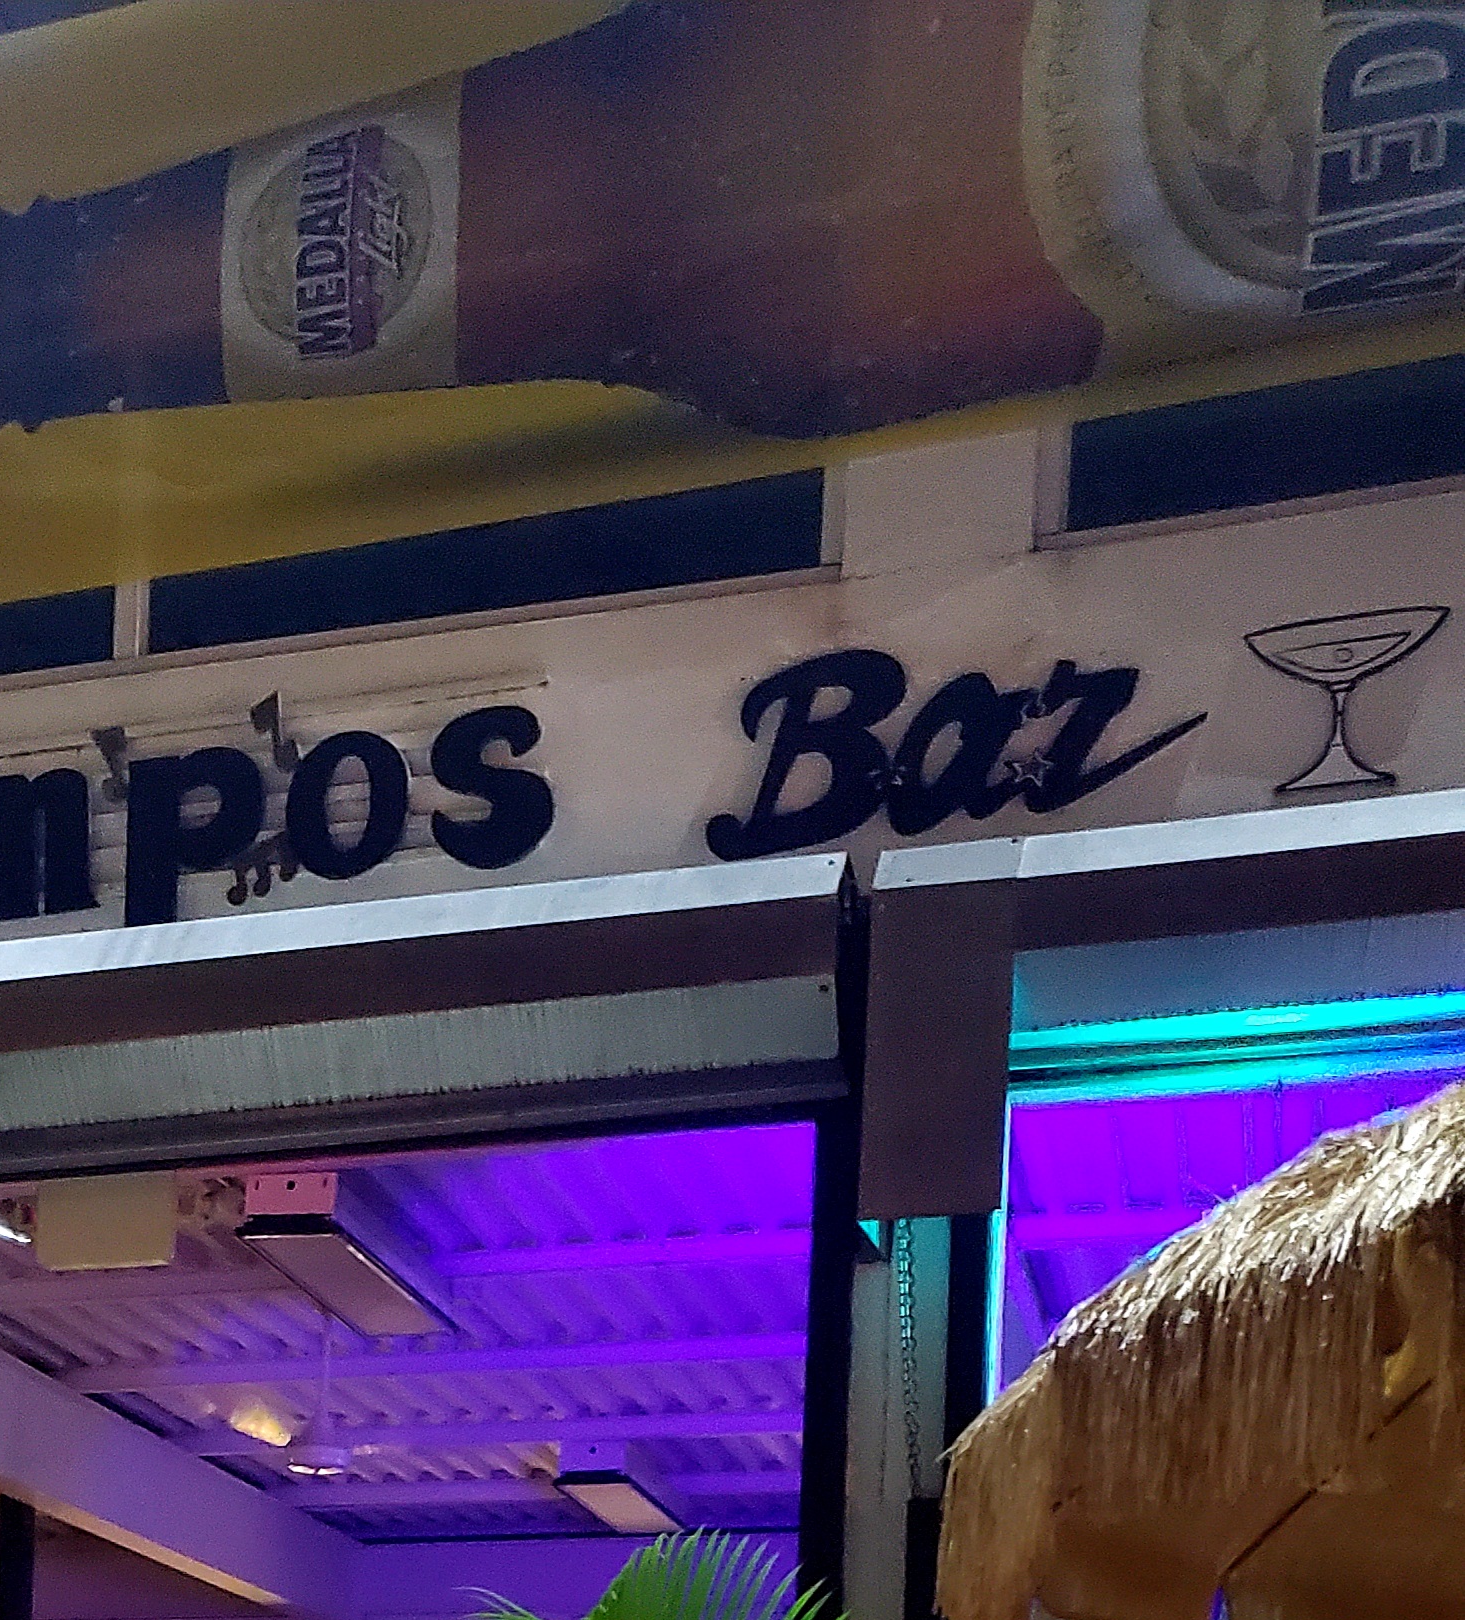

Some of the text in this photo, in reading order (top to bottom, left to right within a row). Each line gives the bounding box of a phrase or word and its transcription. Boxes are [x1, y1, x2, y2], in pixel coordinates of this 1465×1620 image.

[295, 128, 360, 359] MEDALLA
[1302, 0, 1465, 313] MED
[706, 648, 1209, 862] Bar
